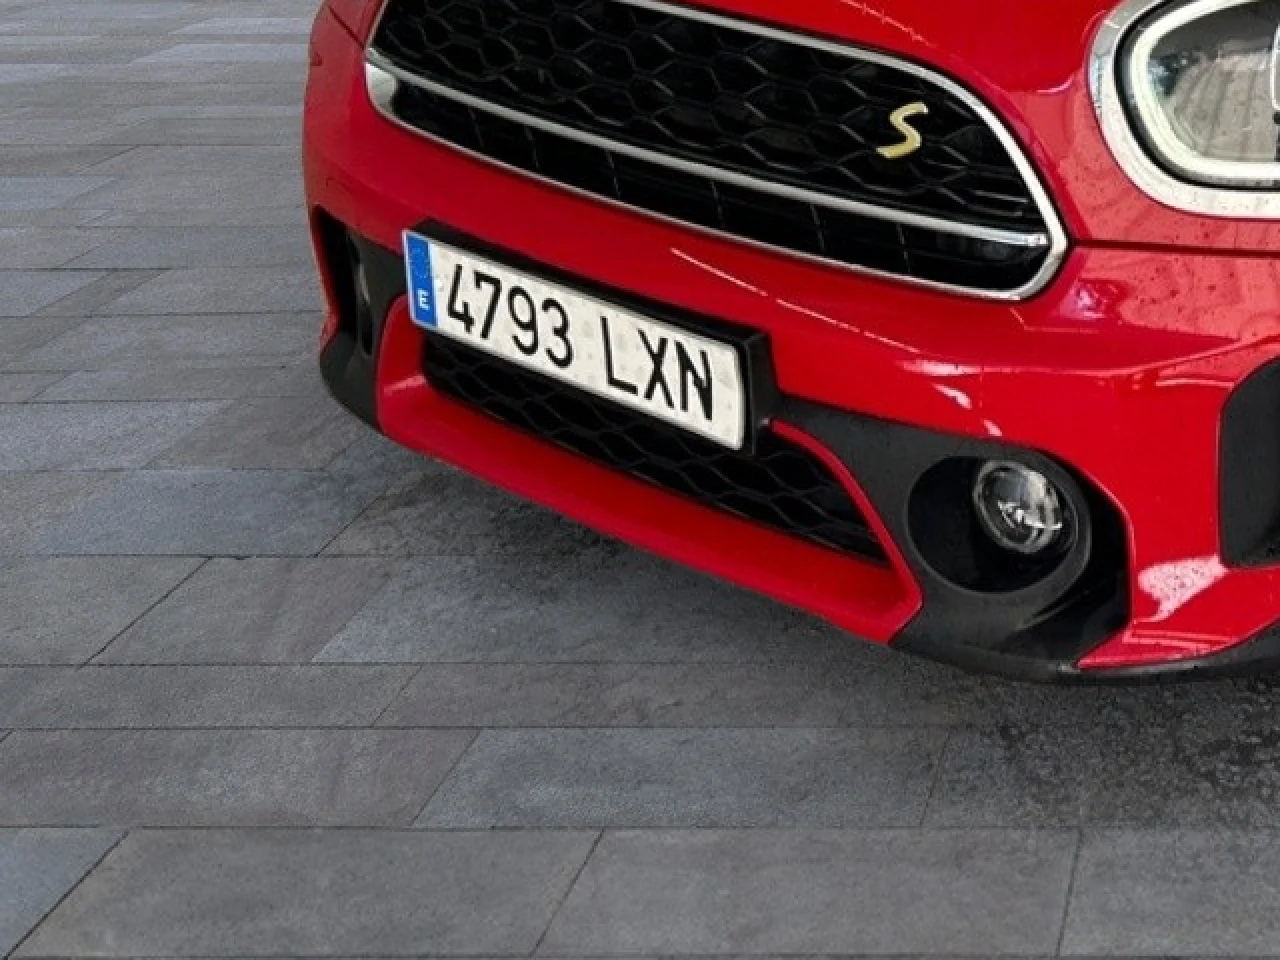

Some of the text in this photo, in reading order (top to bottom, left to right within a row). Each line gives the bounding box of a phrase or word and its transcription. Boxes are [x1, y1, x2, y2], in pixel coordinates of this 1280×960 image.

[875, 101, 929, 159] S
[417, 288, 430, 311] E
[447, 263, 713, 421] 4793 LXN
